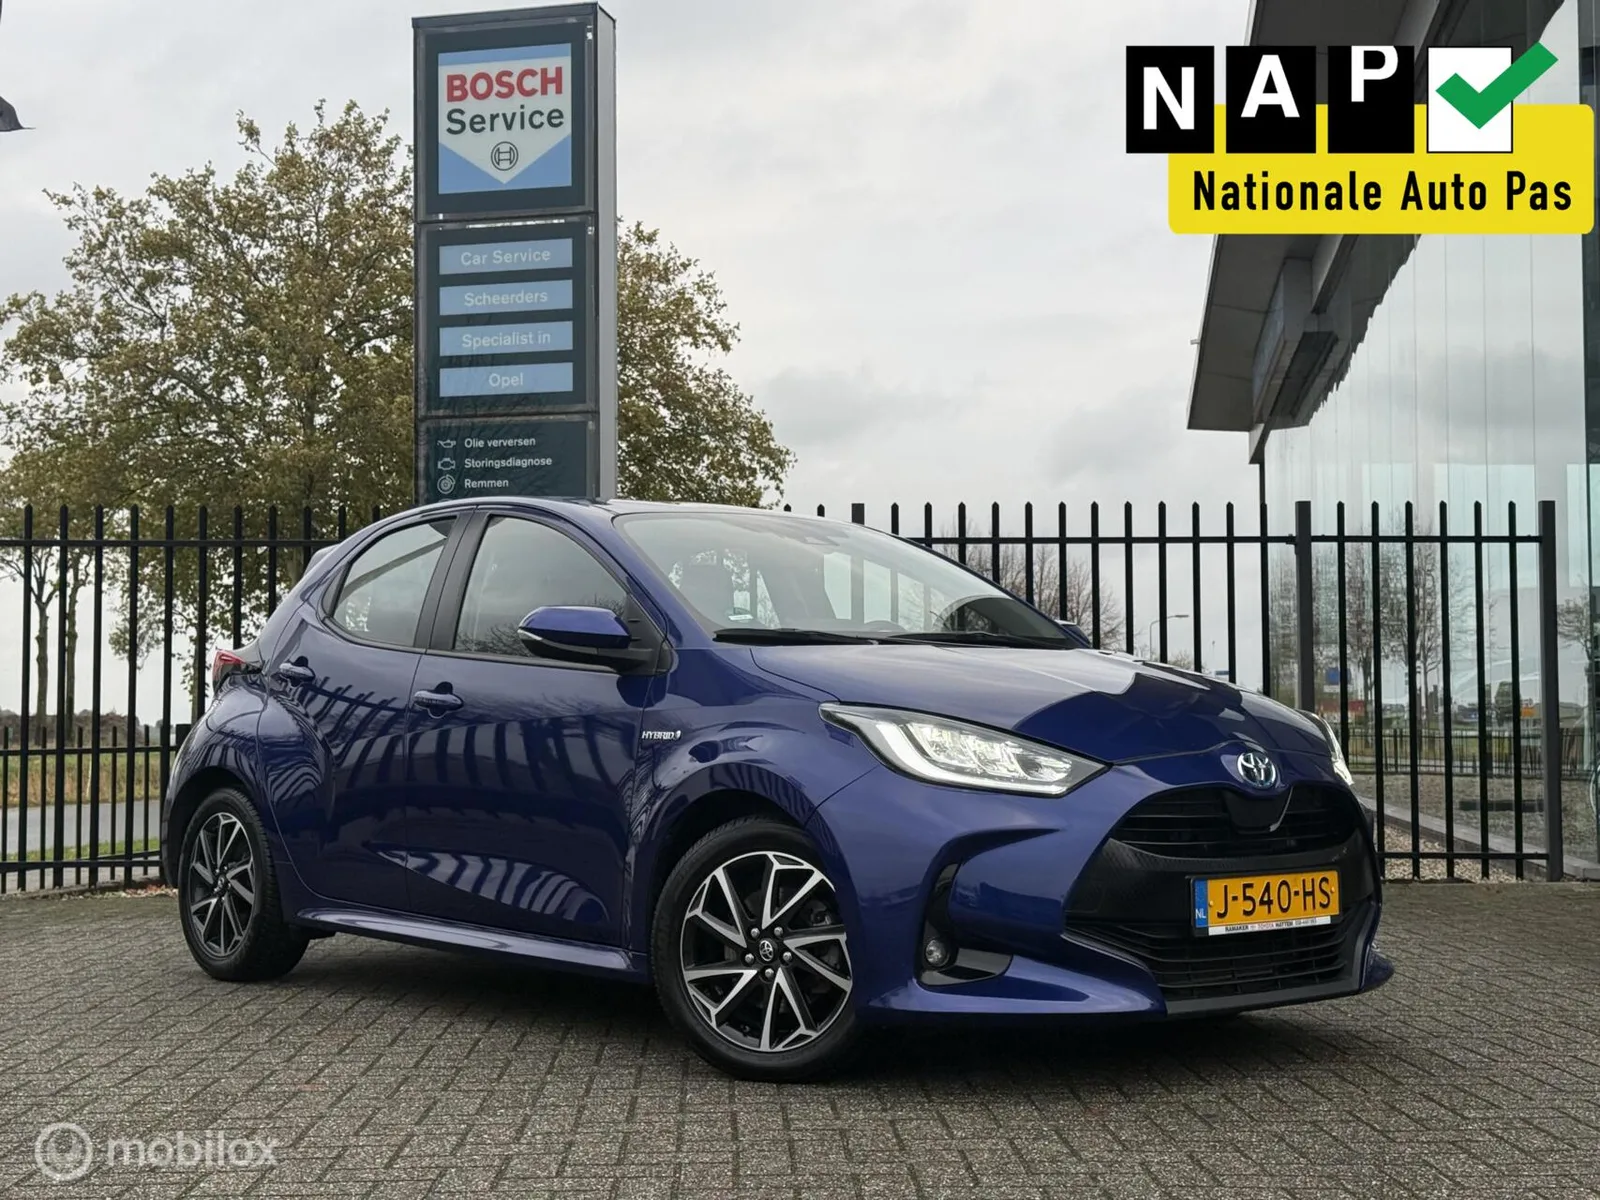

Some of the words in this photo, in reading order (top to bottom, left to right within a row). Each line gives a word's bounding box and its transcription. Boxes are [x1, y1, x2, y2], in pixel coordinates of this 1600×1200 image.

[446, 66, 563, 103] BOSCH
[446, 104, 564, 135] Service
[460, 251, 488, 266] Car
[492, 248, 551, 264] Service
[464, 289, 549, 307] Scheerders
[462, 331, 534, 350] Specialist
[538, 330, 551, 344] in
[488, 372, 524, 388] Opel
[464, 438, 485, 449] Olie
[487, 437, 536, 447] verversen
[464, 456, 553, 469] Storingsdiagnose
[464, 478, 509, 488] Remmen
[641, 730, 675, 740] HYBRID
[1216, 876, 1331, 919] J-540-HS
[1195, 907, 1207, 919] NL
